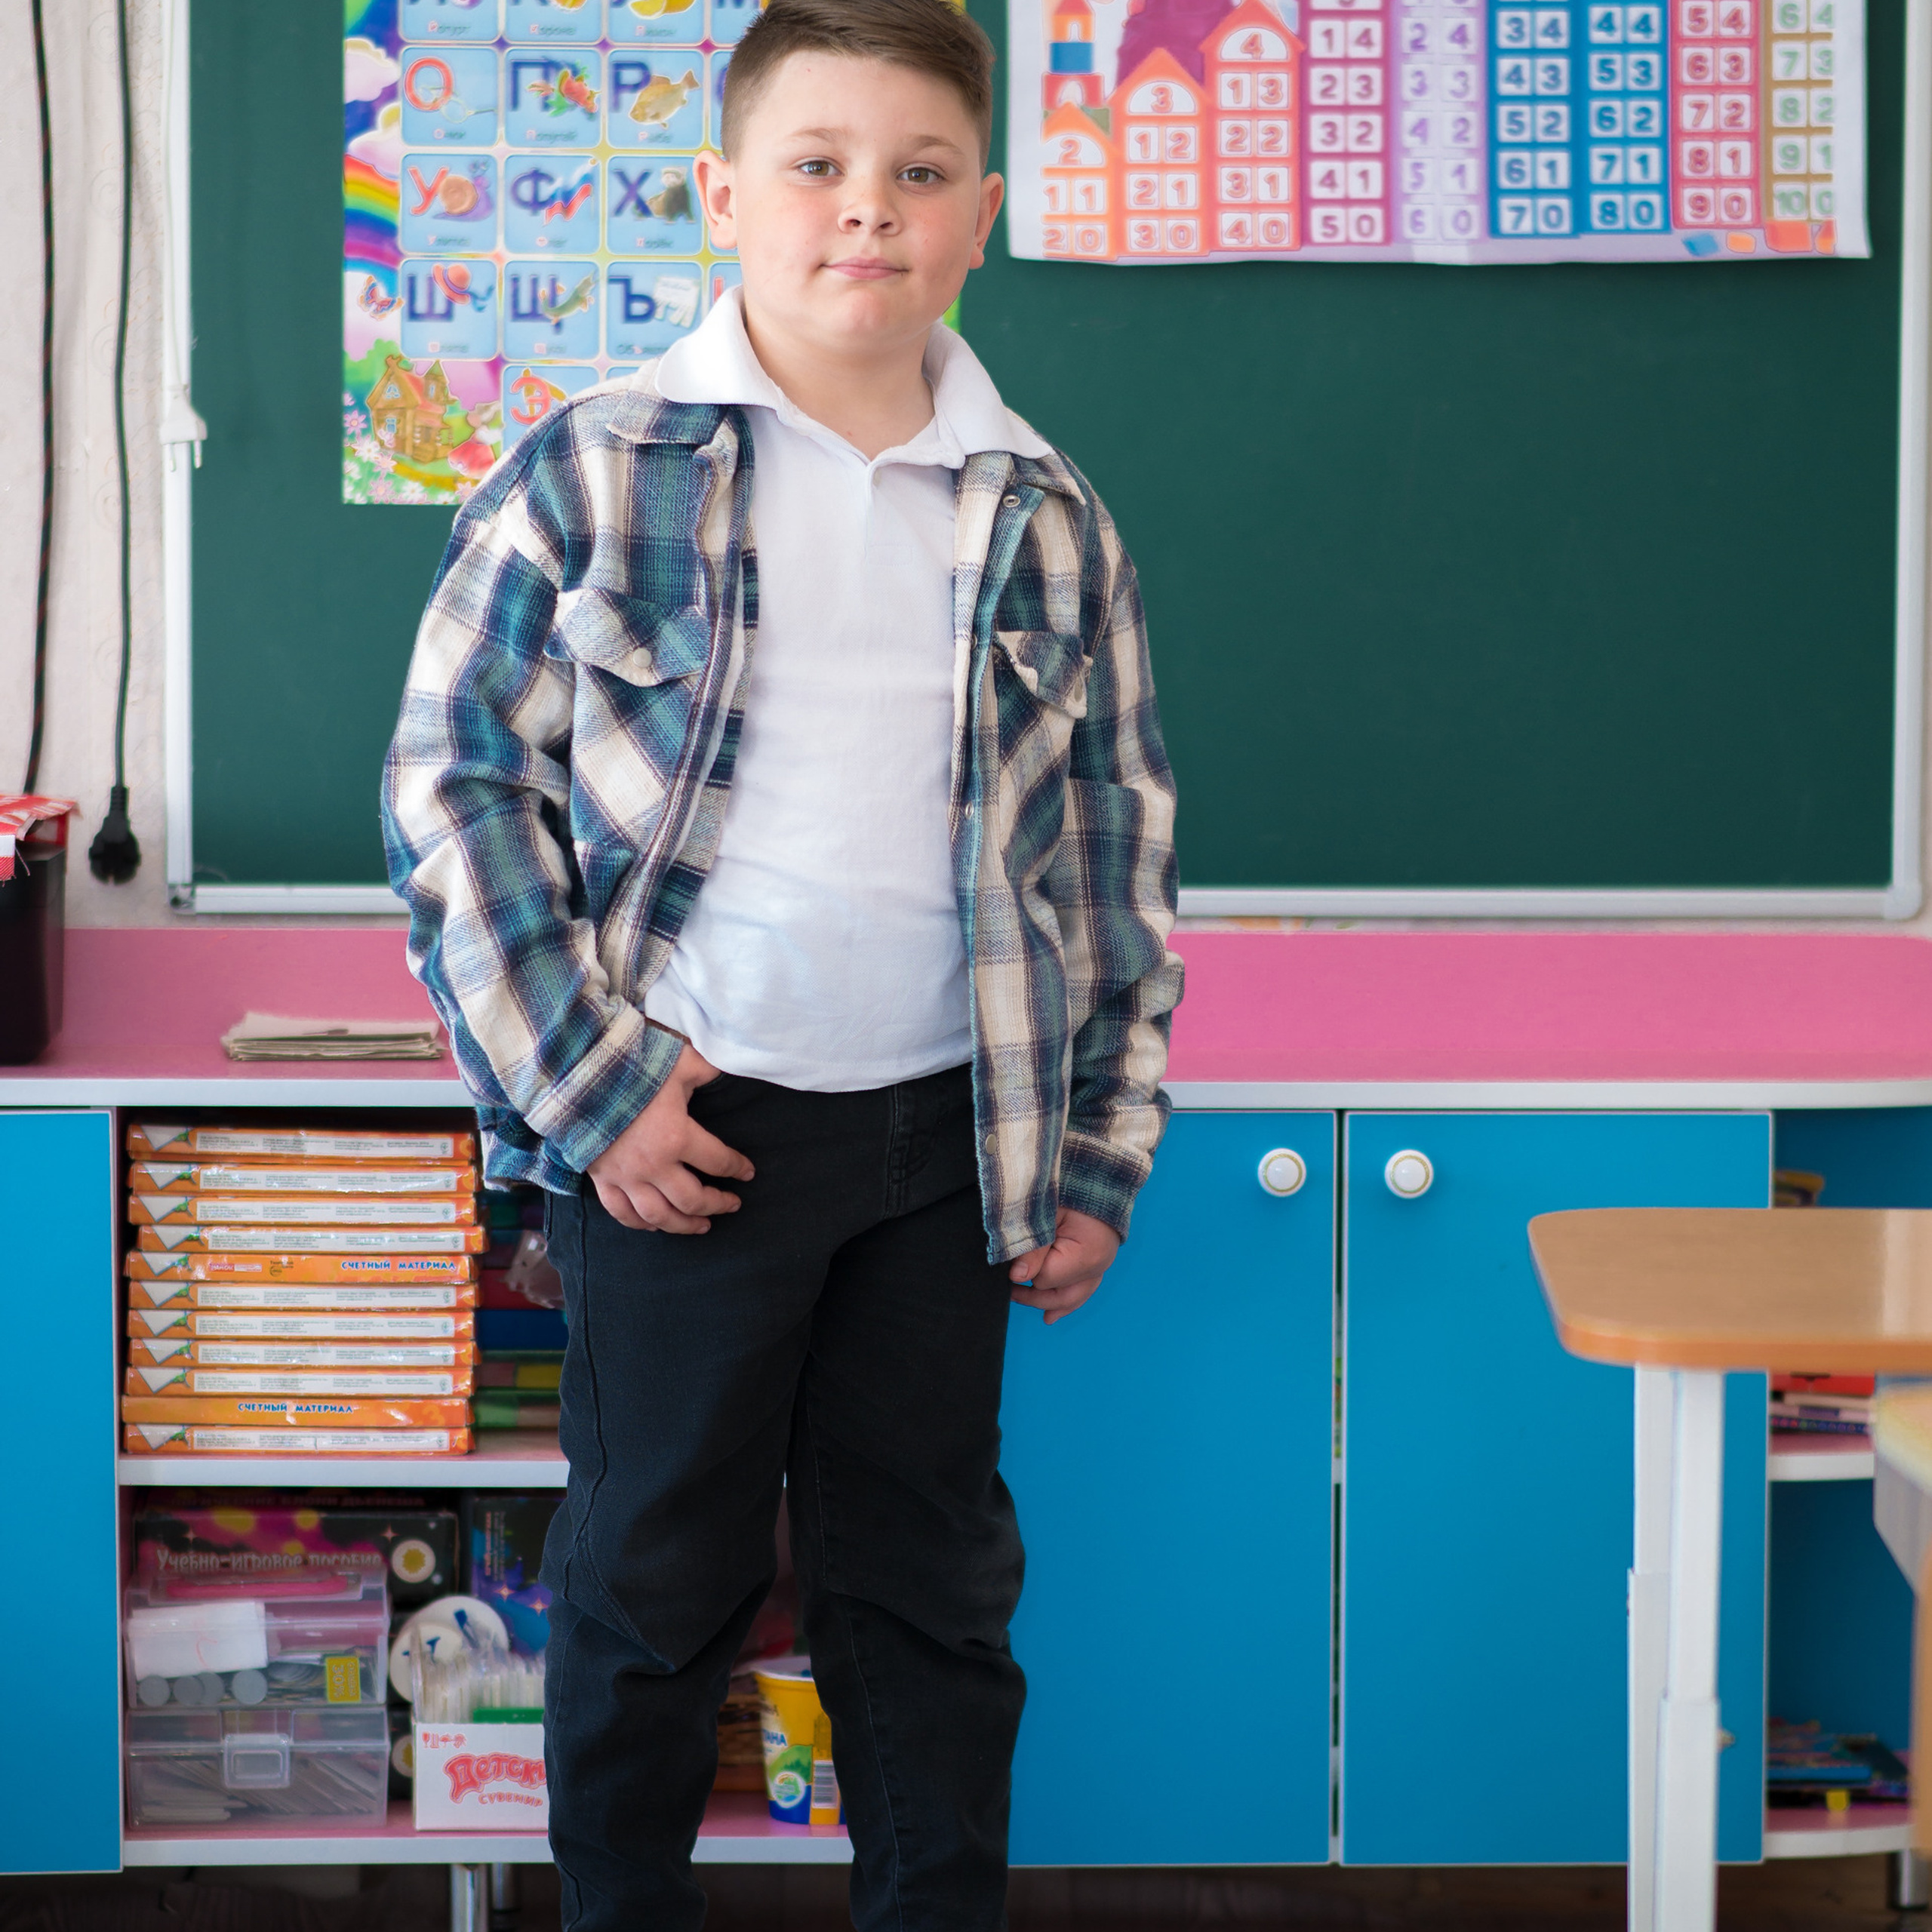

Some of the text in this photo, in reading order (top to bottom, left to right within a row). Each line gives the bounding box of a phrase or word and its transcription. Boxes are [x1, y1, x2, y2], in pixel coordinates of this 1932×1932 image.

[1241, 34, 1263, 60] 4
[405, 58, 453, 111] О
[510, 59, 555, 112] П
[612, 61, 652, 112] Р
[1151, 87, 1173, 112] 3
[1060, 139, 1081, 165] 2
[408, 167, 449, 215] У
[512, 168, 556, 217] Ф
[614, 169, 654, 217] Х
[408, 275, 453, 322] Ш
[512, 275, 563, 333] Щ
[608, 275, 656, 324] Ъ
[510, 377, 552, 425] Э
[341, 1260, 456, 1270] СЧЕТНЫЙ МАТЕРИАЛ
[238, 1401, 353, 1414] СЧЕТНЫЙ МАТЕРИАЛ
[478, 1792, 543, 1807] СУВЕНИР
